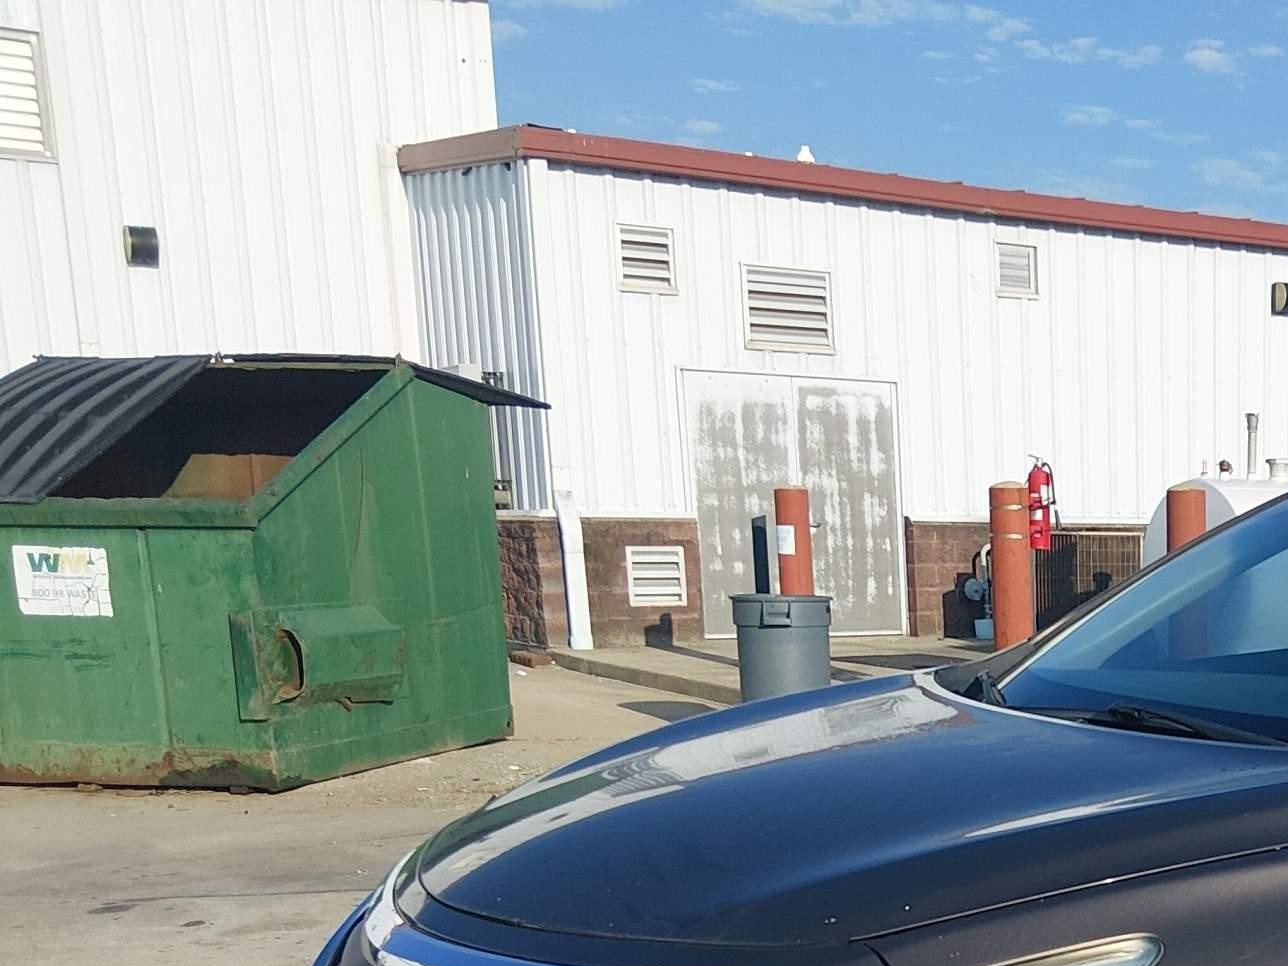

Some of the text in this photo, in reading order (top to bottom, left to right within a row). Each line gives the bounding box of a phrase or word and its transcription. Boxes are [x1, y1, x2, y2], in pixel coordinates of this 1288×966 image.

[32, 588, 98, 601] 800 98 WASTE
